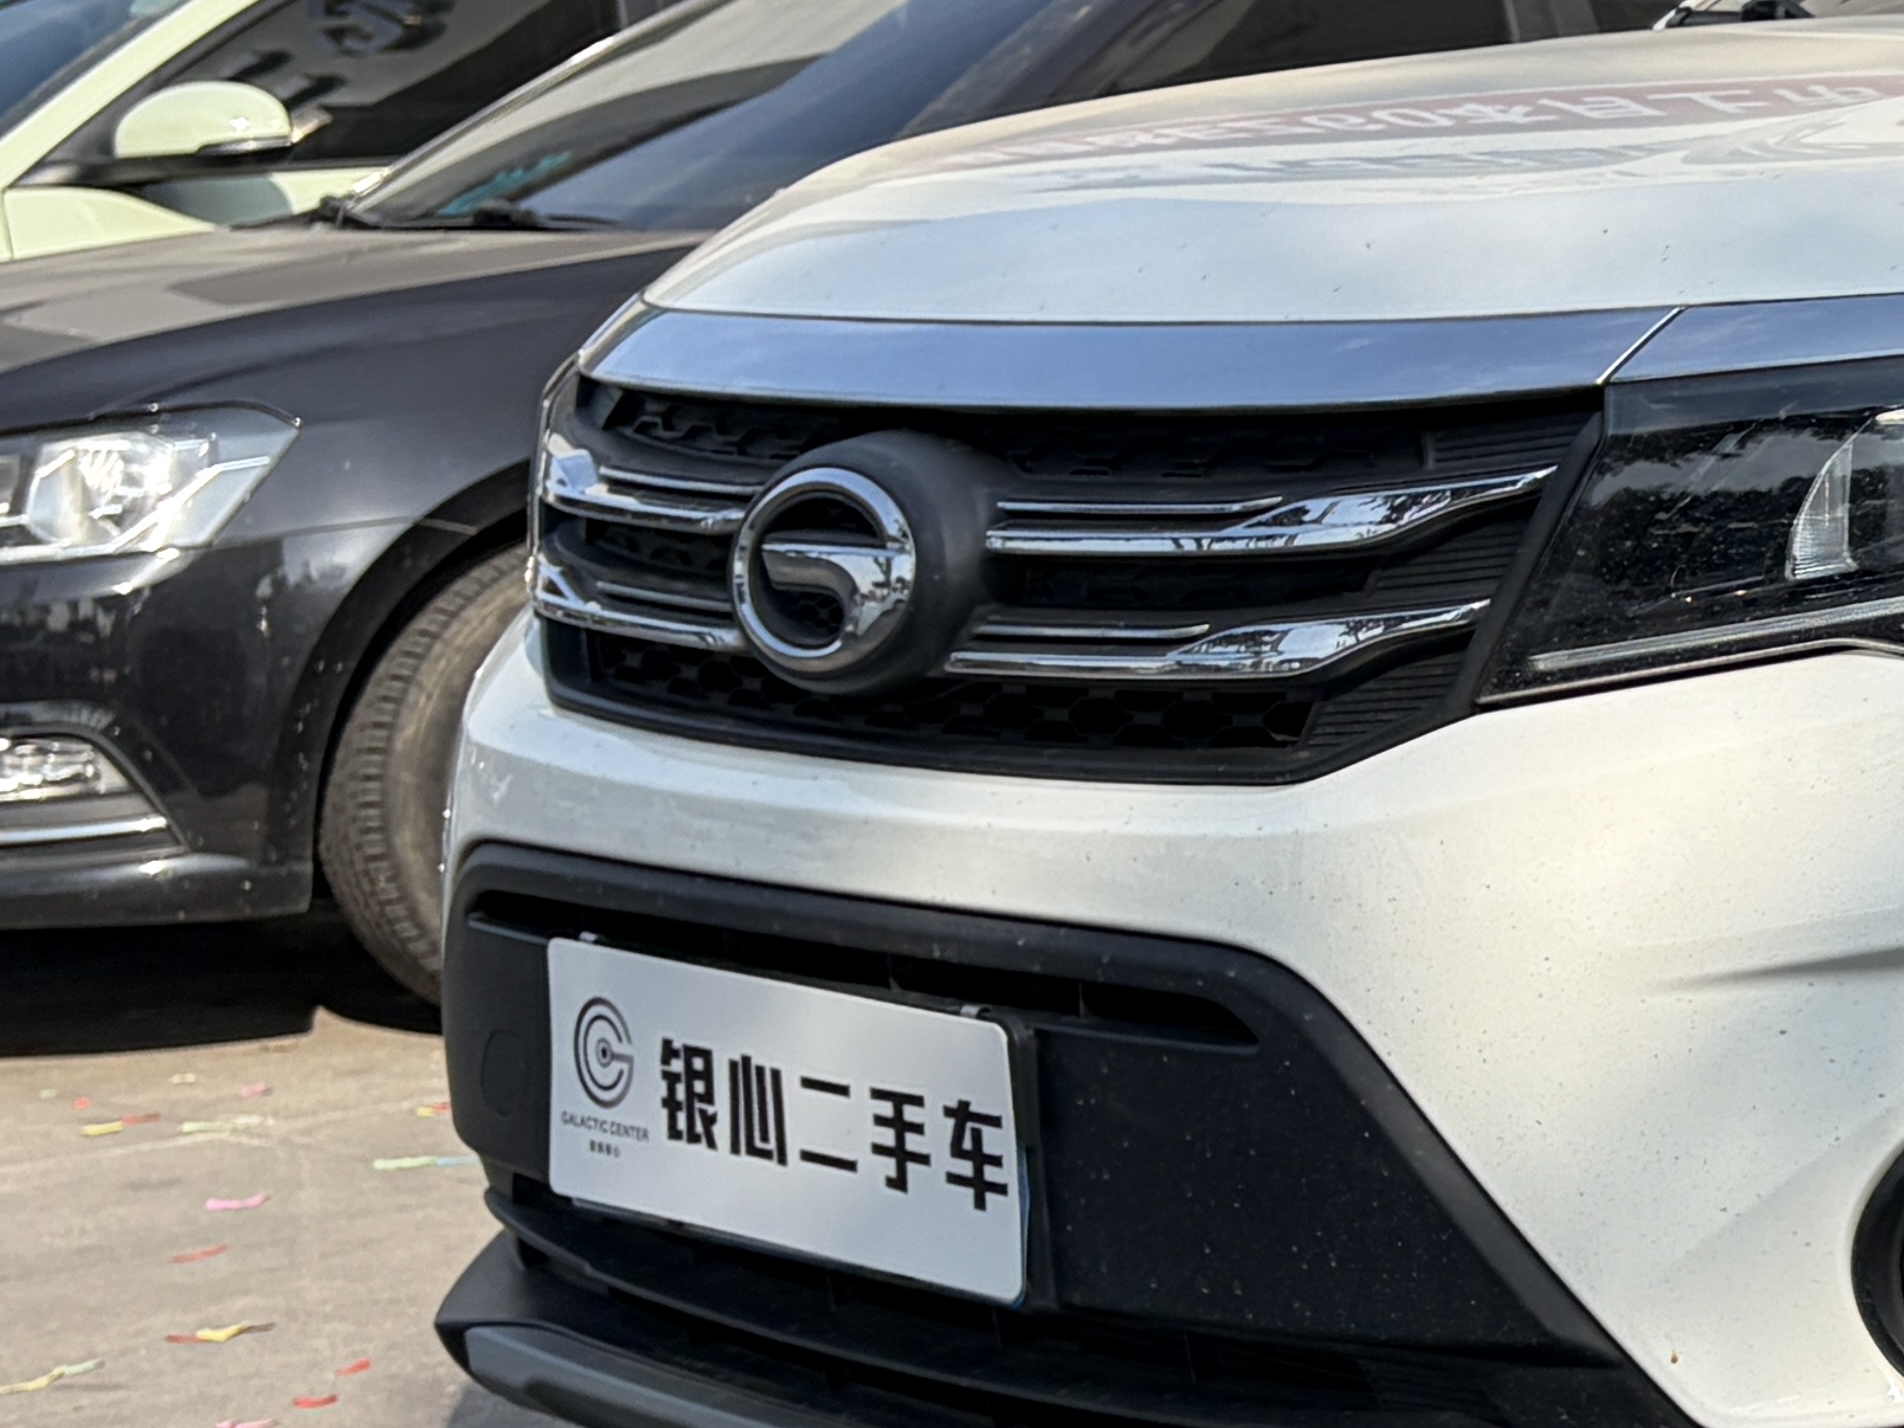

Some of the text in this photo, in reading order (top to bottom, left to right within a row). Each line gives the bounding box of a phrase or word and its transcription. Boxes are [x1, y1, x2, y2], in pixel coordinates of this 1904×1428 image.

[560, 1109, 651, 1143] GALACTIC CENTER
[659, 1037, 1010, 1213] 银心二手车
